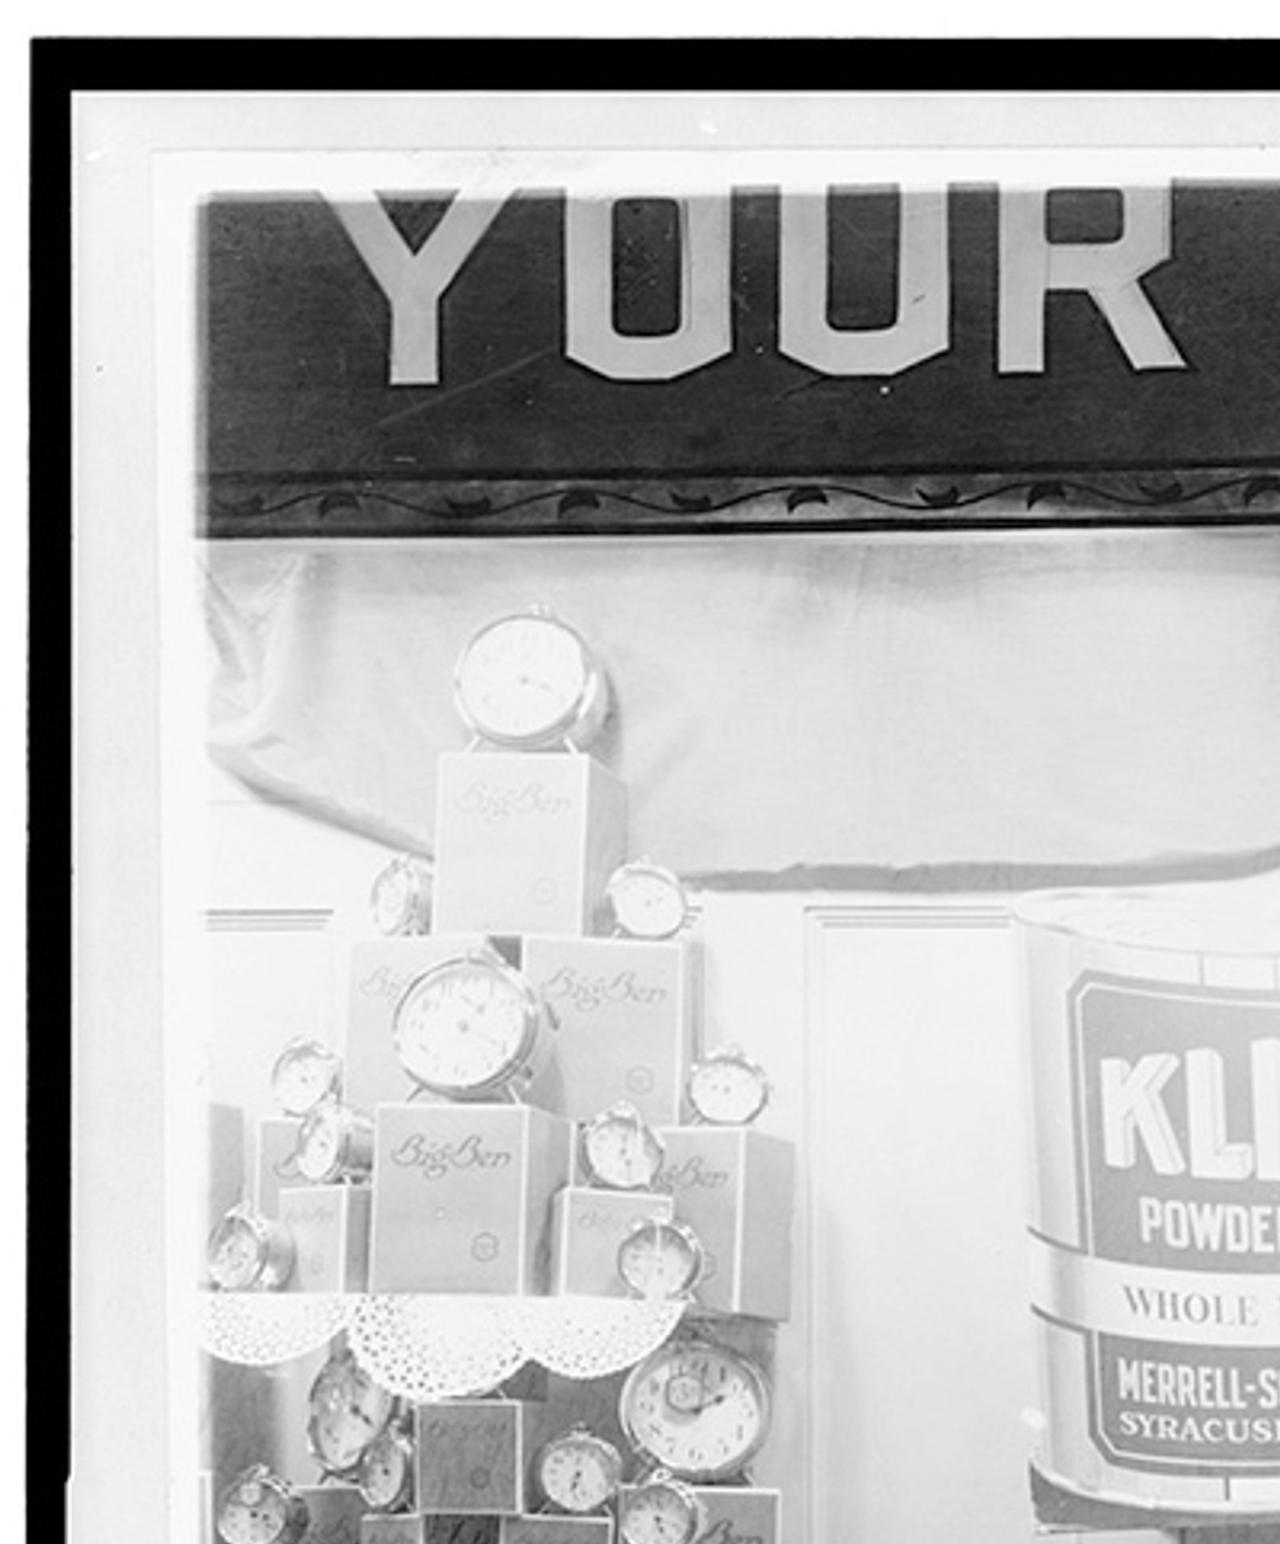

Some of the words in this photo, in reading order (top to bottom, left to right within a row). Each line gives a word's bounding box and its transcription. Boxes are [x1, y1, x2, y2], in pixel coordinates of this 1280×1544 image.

[318, 183, 1186, 386] YOUR
[389, 1131, 448, 1182] Big
[449, 1132, 512, 1170] Ben
[1119, 1281, 1262, 1328] WHOLE
